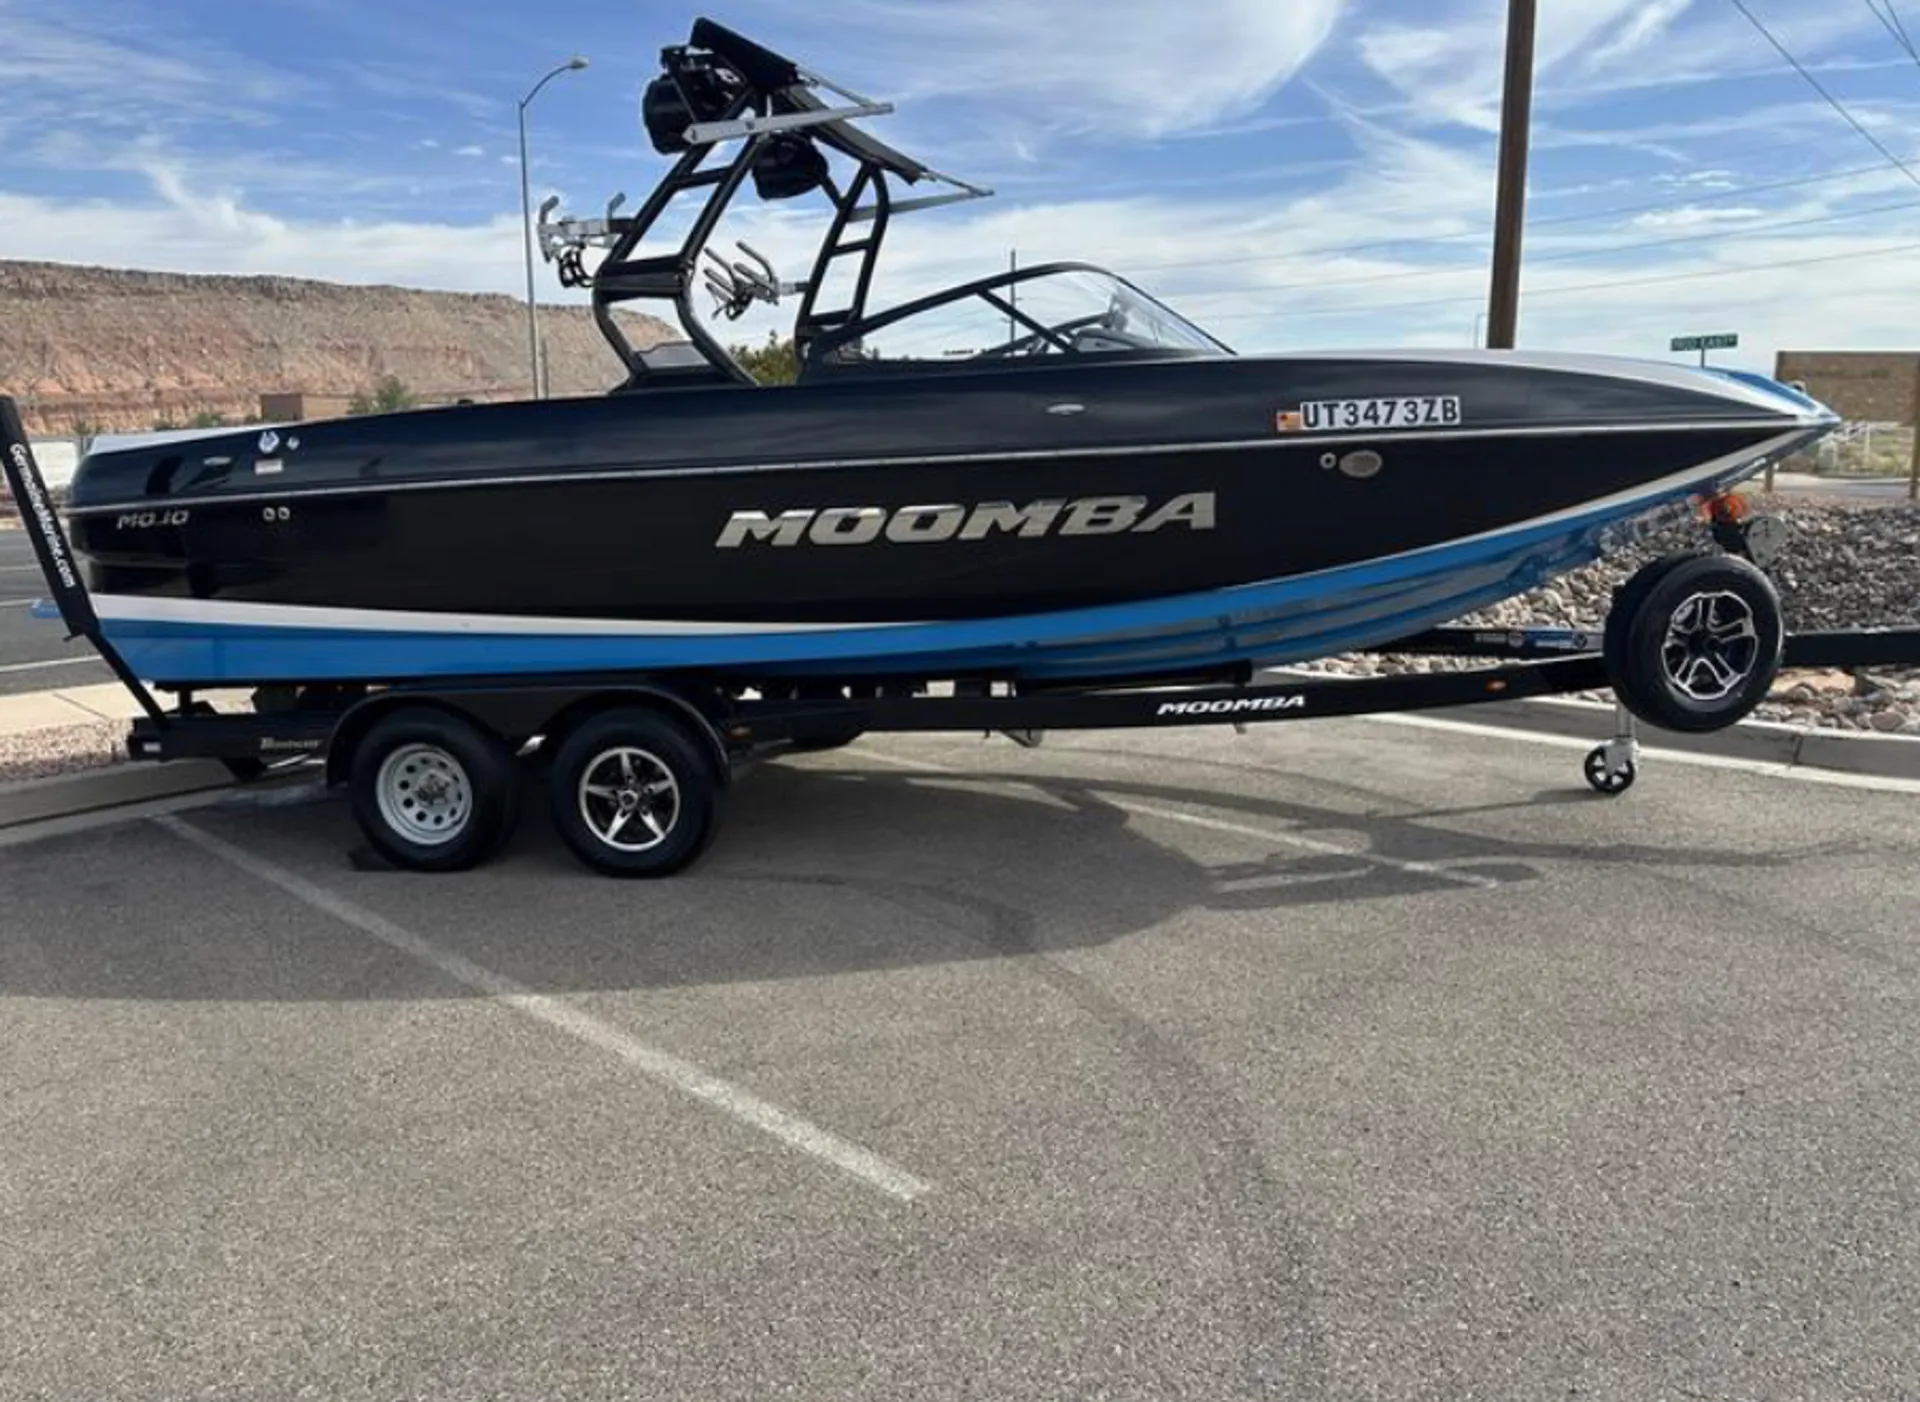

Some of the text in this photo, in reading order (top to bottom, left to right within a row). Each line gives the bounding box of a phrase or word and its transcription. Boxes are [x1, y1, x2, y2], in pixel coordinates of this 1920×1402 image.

[1302, 399, 1458, 428] UT3473ZB
[116, 509, 191, 530] MOJO
[715, 492, 1216, 548] MOOMBA
[1156, 694, 1306, 715] MOOMBA
